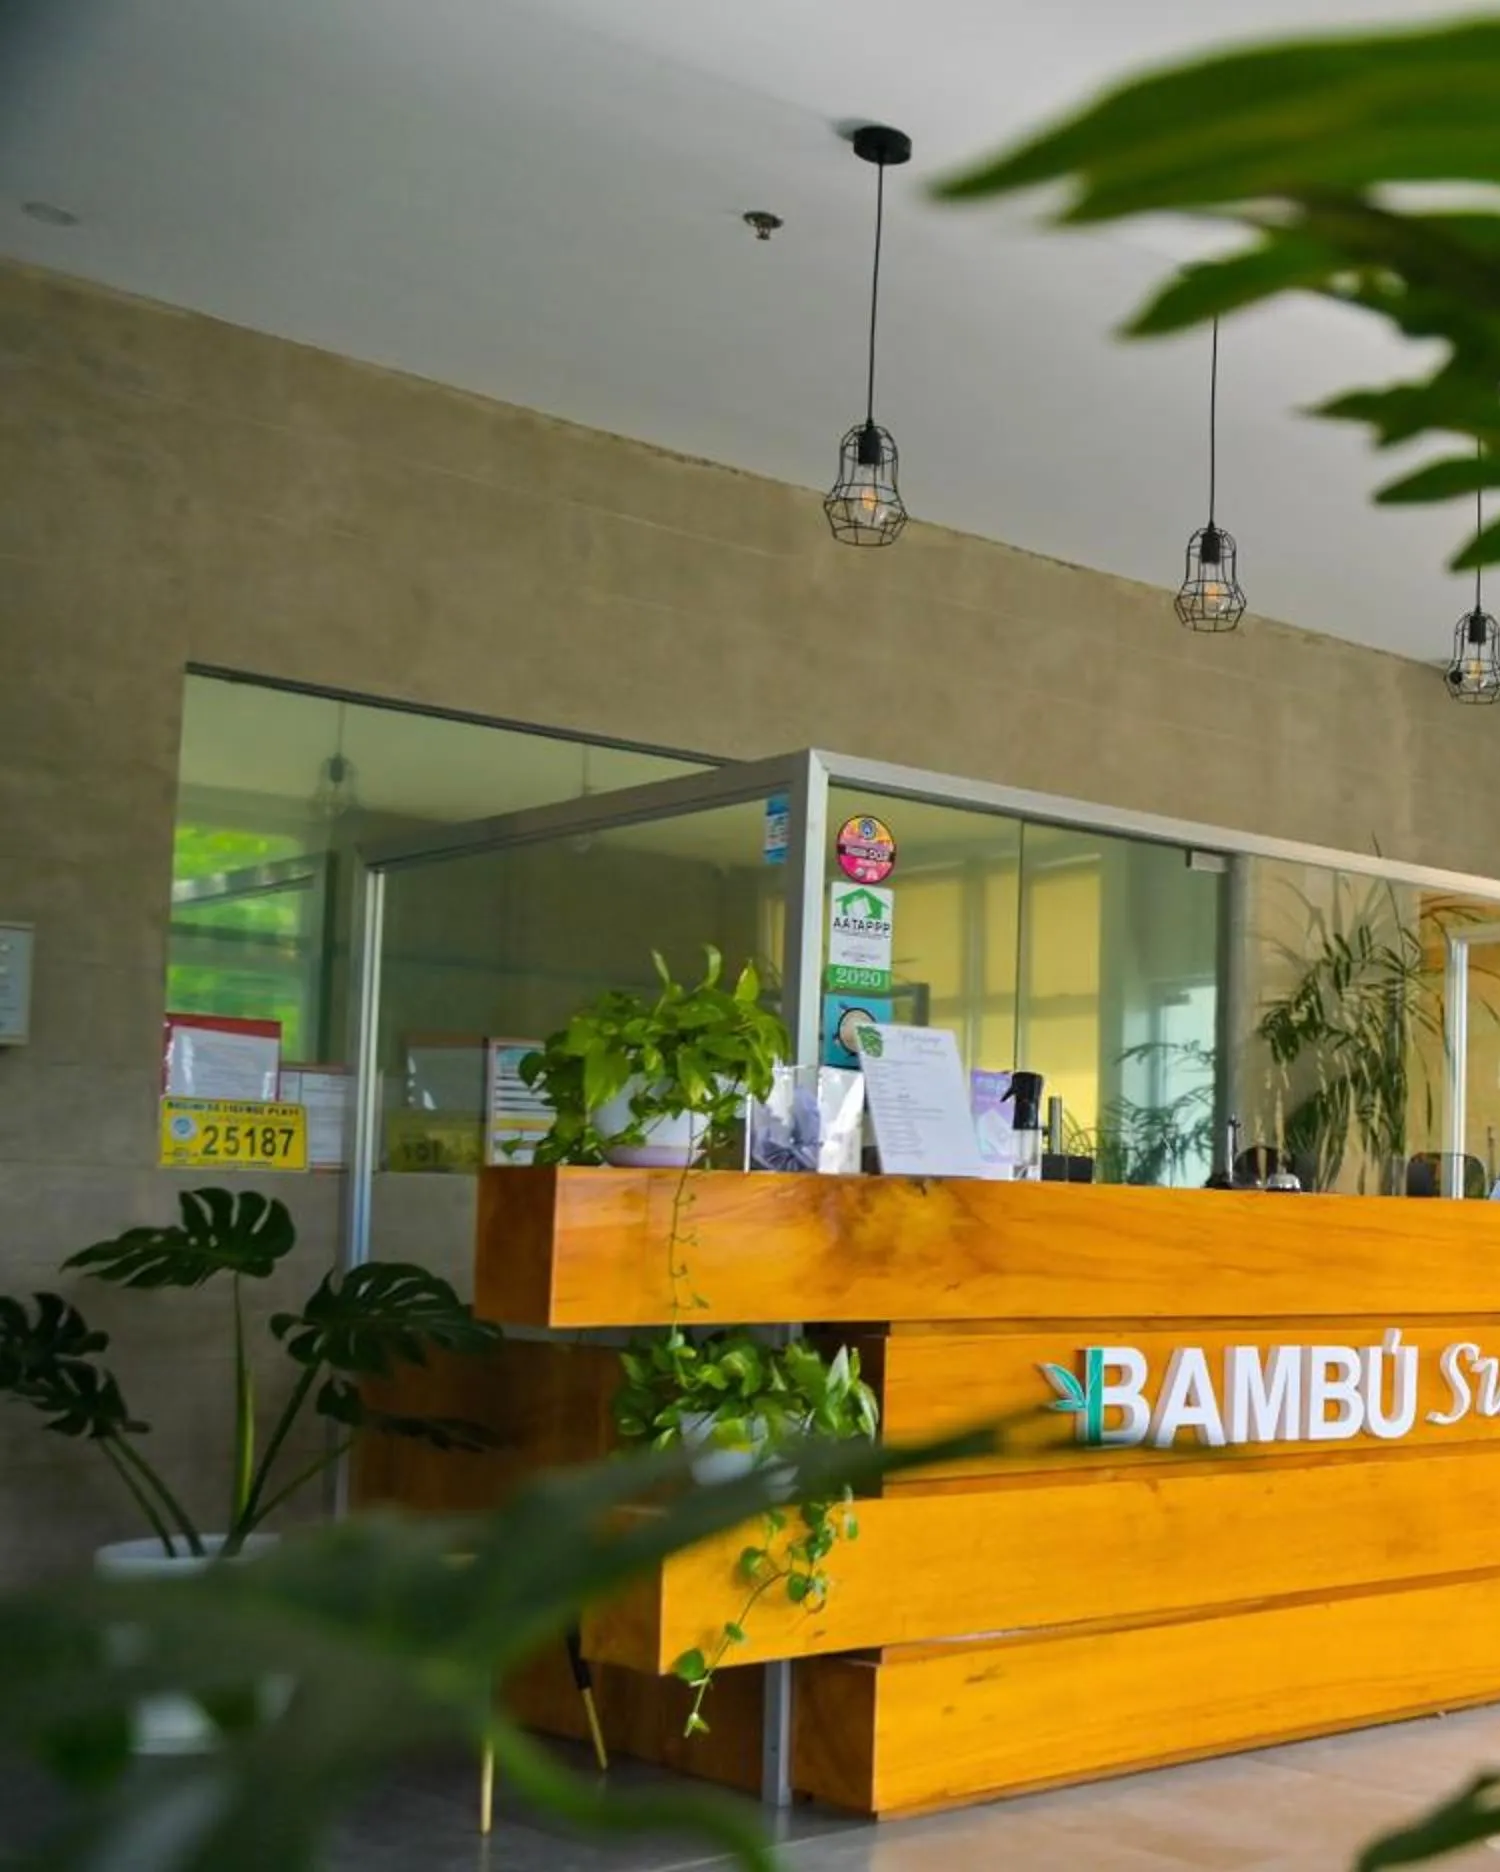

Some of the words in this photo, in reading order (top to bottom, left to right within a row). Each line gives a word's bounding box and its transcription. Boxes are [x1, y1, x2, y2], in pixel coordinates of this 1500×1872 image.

[833, 917, 890, 933] AATAPPP
[835, 967, 881, 986] 2020
[202, 1125, 295, 1157] 25187
[1080, 1328, 1419, 1449] BAMBÚ
